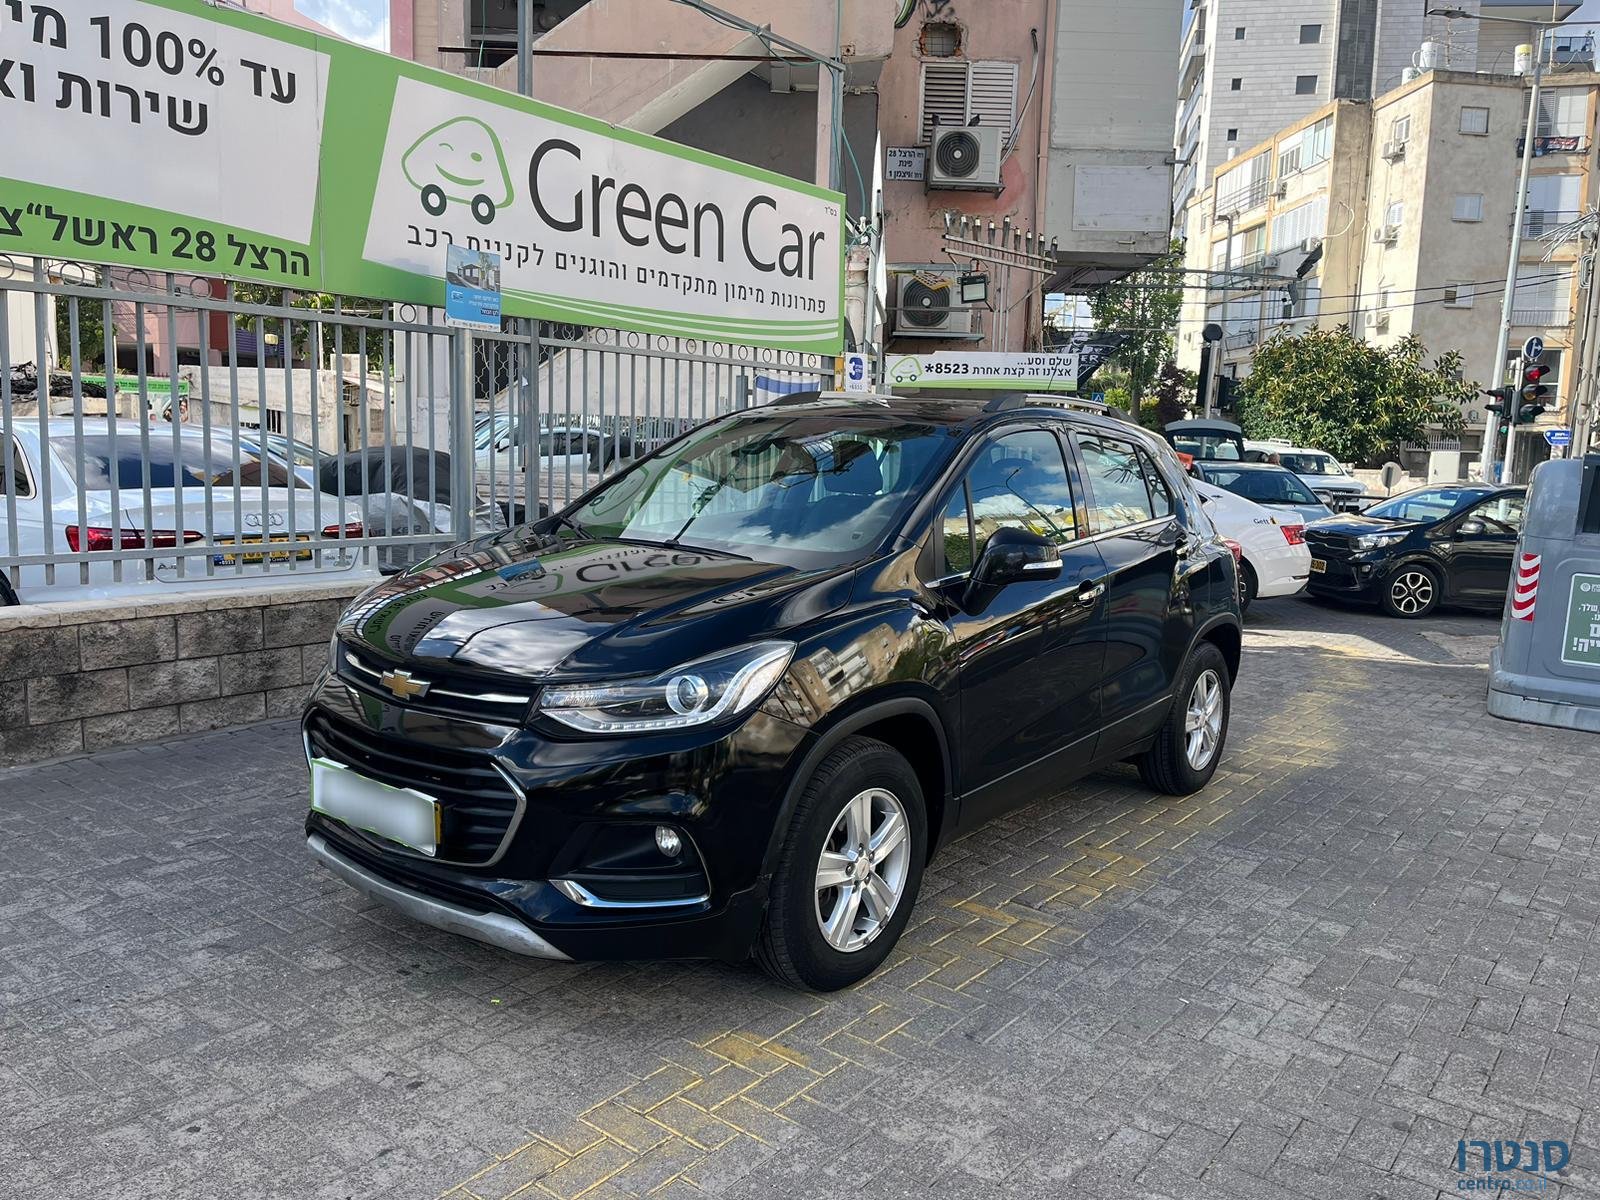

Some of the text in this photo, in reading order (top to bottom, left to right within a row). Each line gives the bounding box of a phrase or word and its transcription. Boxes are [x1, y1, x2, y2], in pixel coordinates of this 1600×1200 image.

[90, 16, 225, 87] 100%
[240, 58, 296, 104] עד
[56, 71, 208, 136] שירות
[528, 138, 825, 281] Green Car
[170, 226, 216, 262] 28
[407, 224, 453, 248] רכב
[227, 233, 310, 277] הרצל
[555, 251, 627, 281] והוגנים
[637, 266, 718, 296] מתקדמים
[725, 282, 765, 303] מימון
[770, 290, 826, 314] פתרונות
[972, 366, 1001, 376] אחרת
[1003, 367, 1025, 378] קצת
[1028, 367, 1040, 376] זה
[1042, 366, 1072, 377] אצלנו
[1049, 356, 1072, 366] שלם
